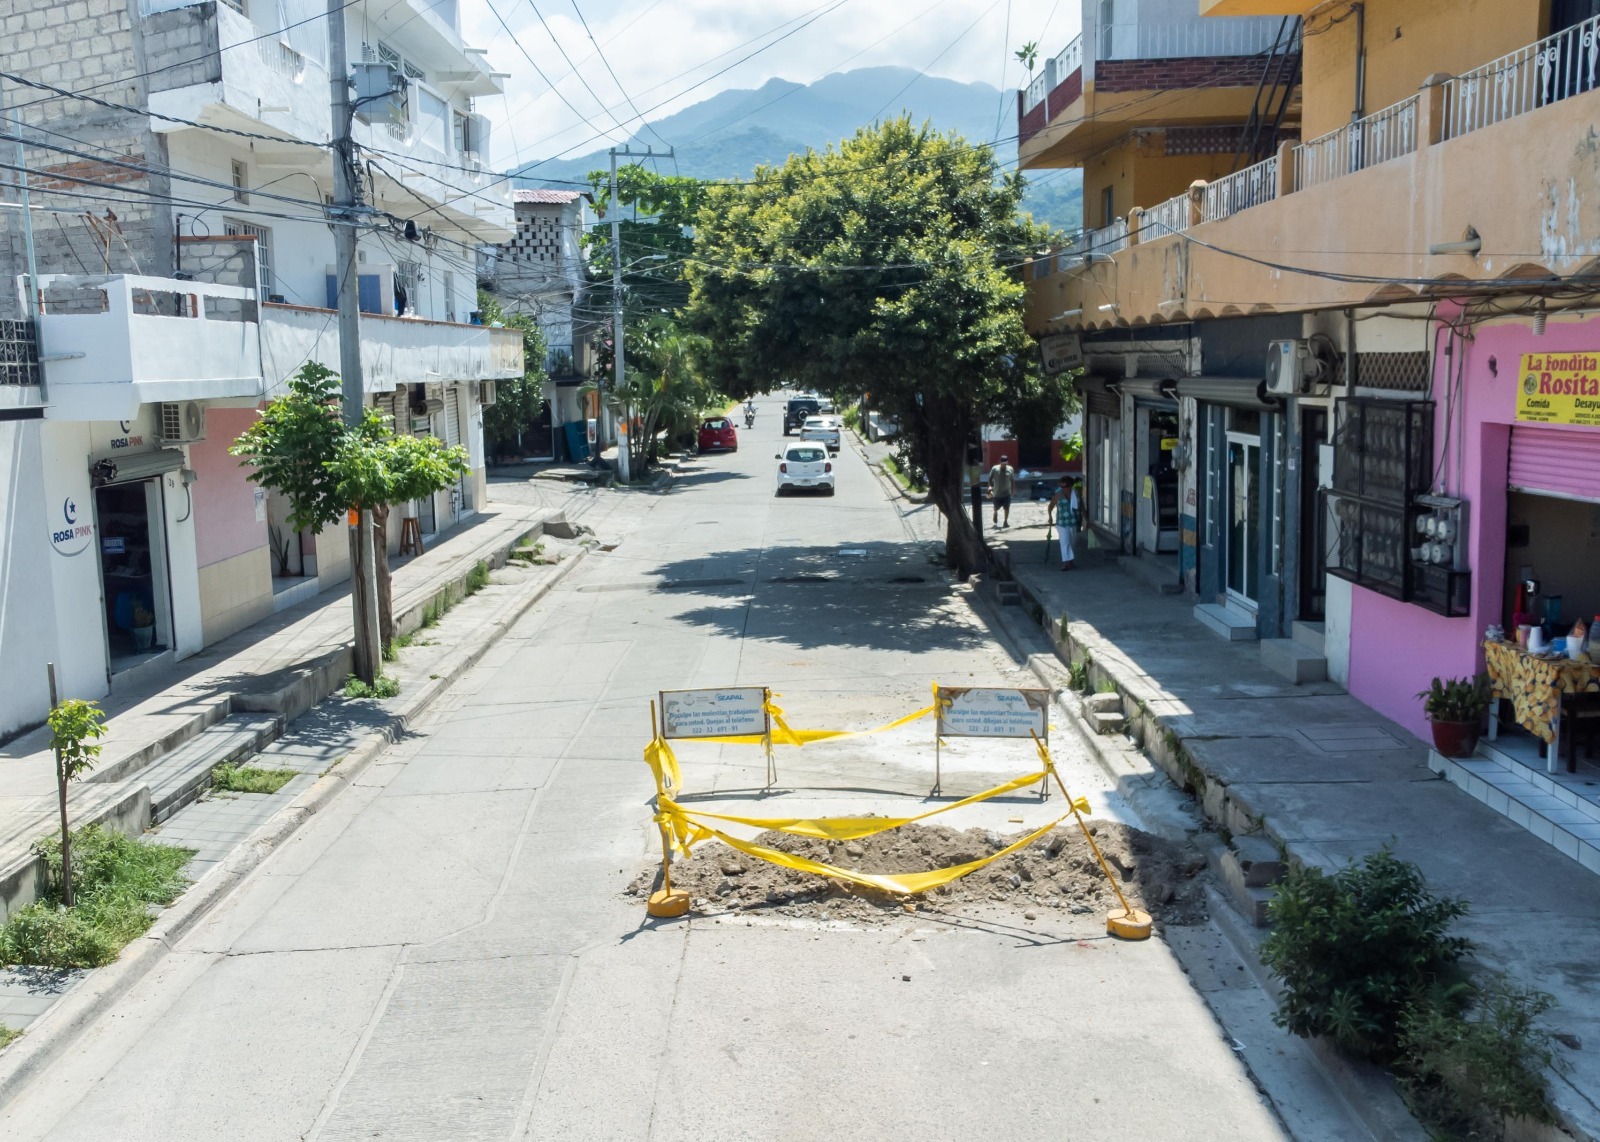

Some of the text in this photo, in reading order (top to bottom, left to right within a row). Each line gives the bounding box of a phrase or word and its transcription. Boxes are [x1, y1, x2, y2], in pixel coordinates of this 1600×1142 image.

[1527, 354, 1542, 371] La
[1539, 372, 1599, 396] Rosita
[1526, 398, 1551, 409] Comida
[110, 435, 144, 450] ROSA PINK
[53, 524, 92, 544] ROSA PINK
[717, 694, 744, 702] SEAPAL
[702, 709, 727, 717] molestias
[728, 708, 759, 716] trabajamos
[983, 717, 1002, 725] Quejas
